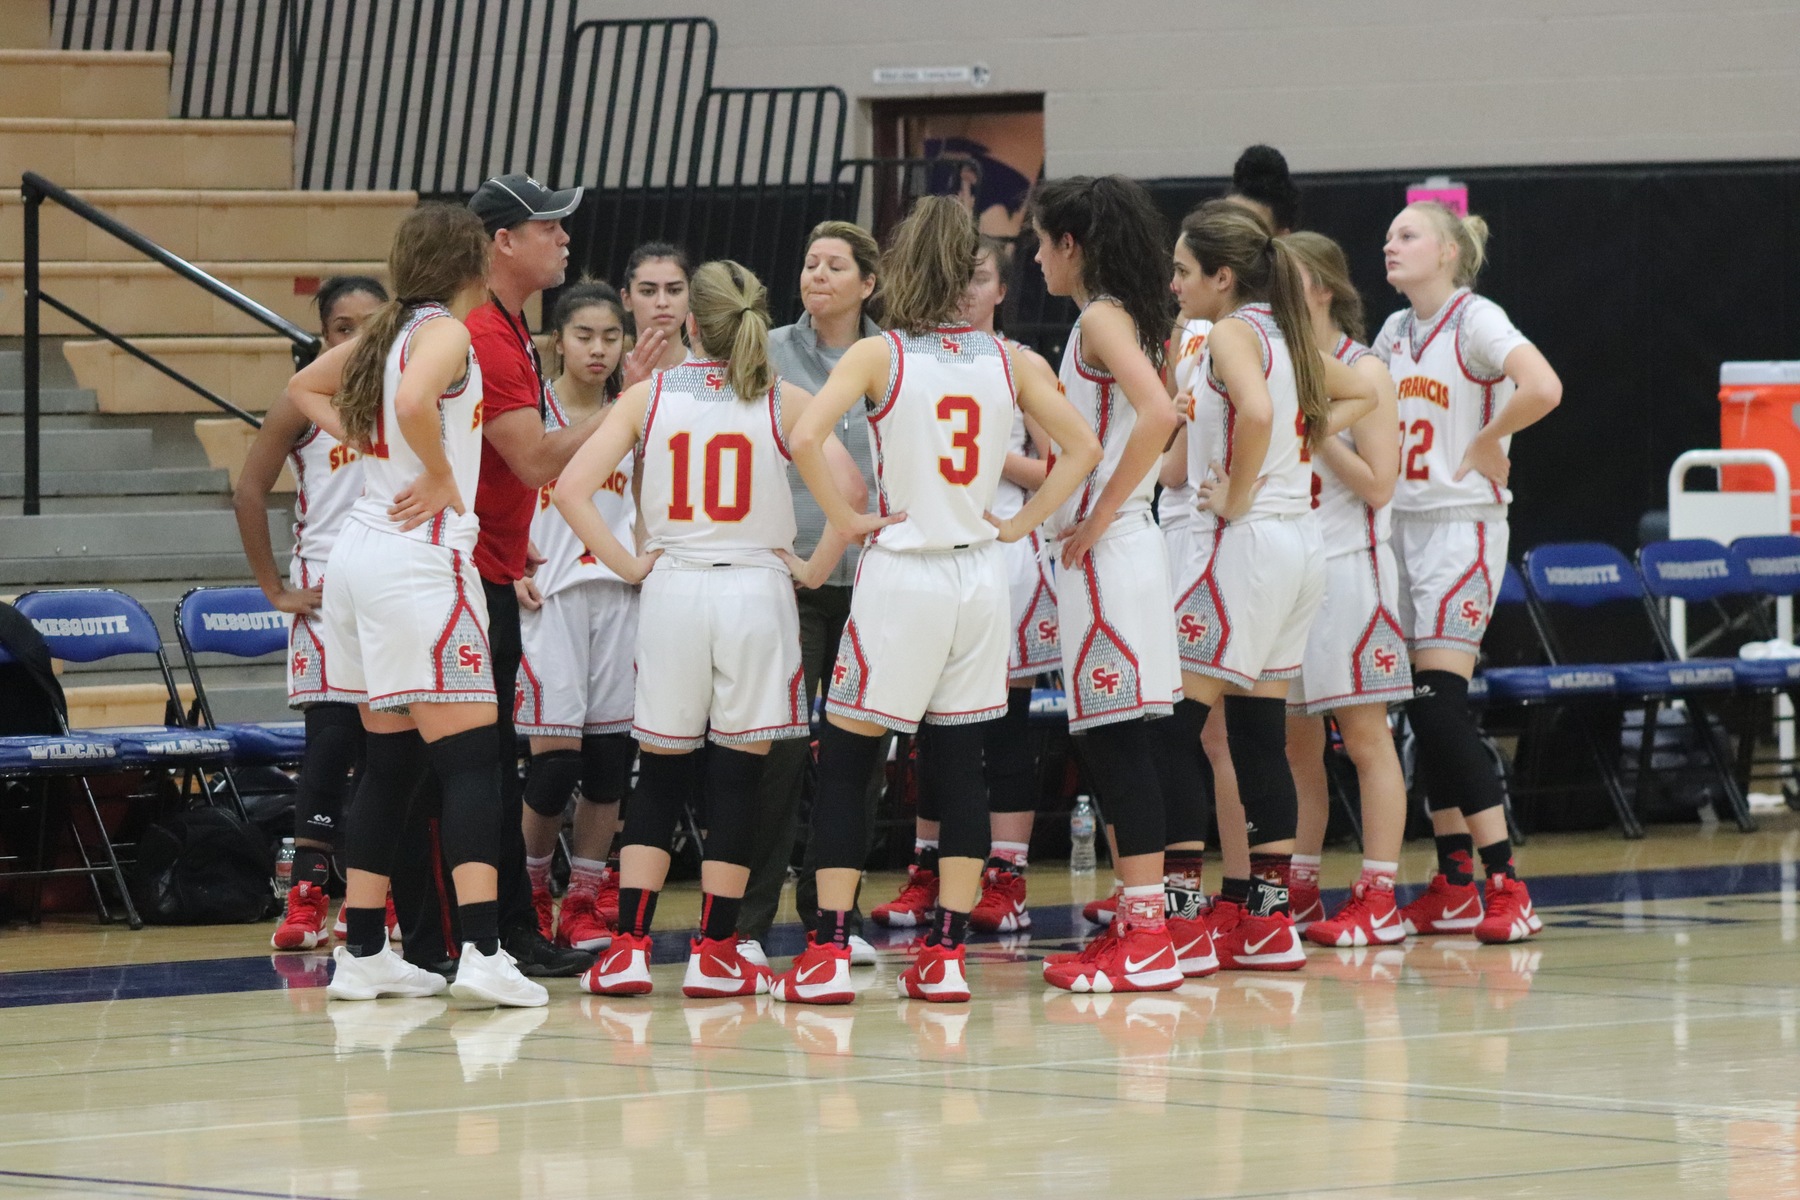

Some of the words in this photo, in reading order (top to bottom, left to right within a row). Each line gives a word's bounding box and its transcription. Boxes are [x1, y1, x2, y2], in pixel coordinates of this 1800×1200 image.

[941, 337, 961, 354] SF
[705, 373, 724, 391] SF
[1398, 376, 1449, 410] FRANCIS
[936, 394, 981, 487] 3
[329, 444, 356, 473] ST.
[667, 430, 753, 523] 10
[31, 615, 129, 637] MESQUITE
[1461, 600, 1482, 627] SF
[1039, 620, 1058, 645] SF
[1178, 614, 1207, 644] SF
[293, 650, 310, 676] SF
[458, 644, 482, 674] SF
[1373, 647, 1397, 675] SF
[1091, 666, 1121, 696] SF
[28, 743, 116, 760] WILDCATS
[146, 739, 230, 756] WILDCATS
[1131, 901, 1160, 919] SF
